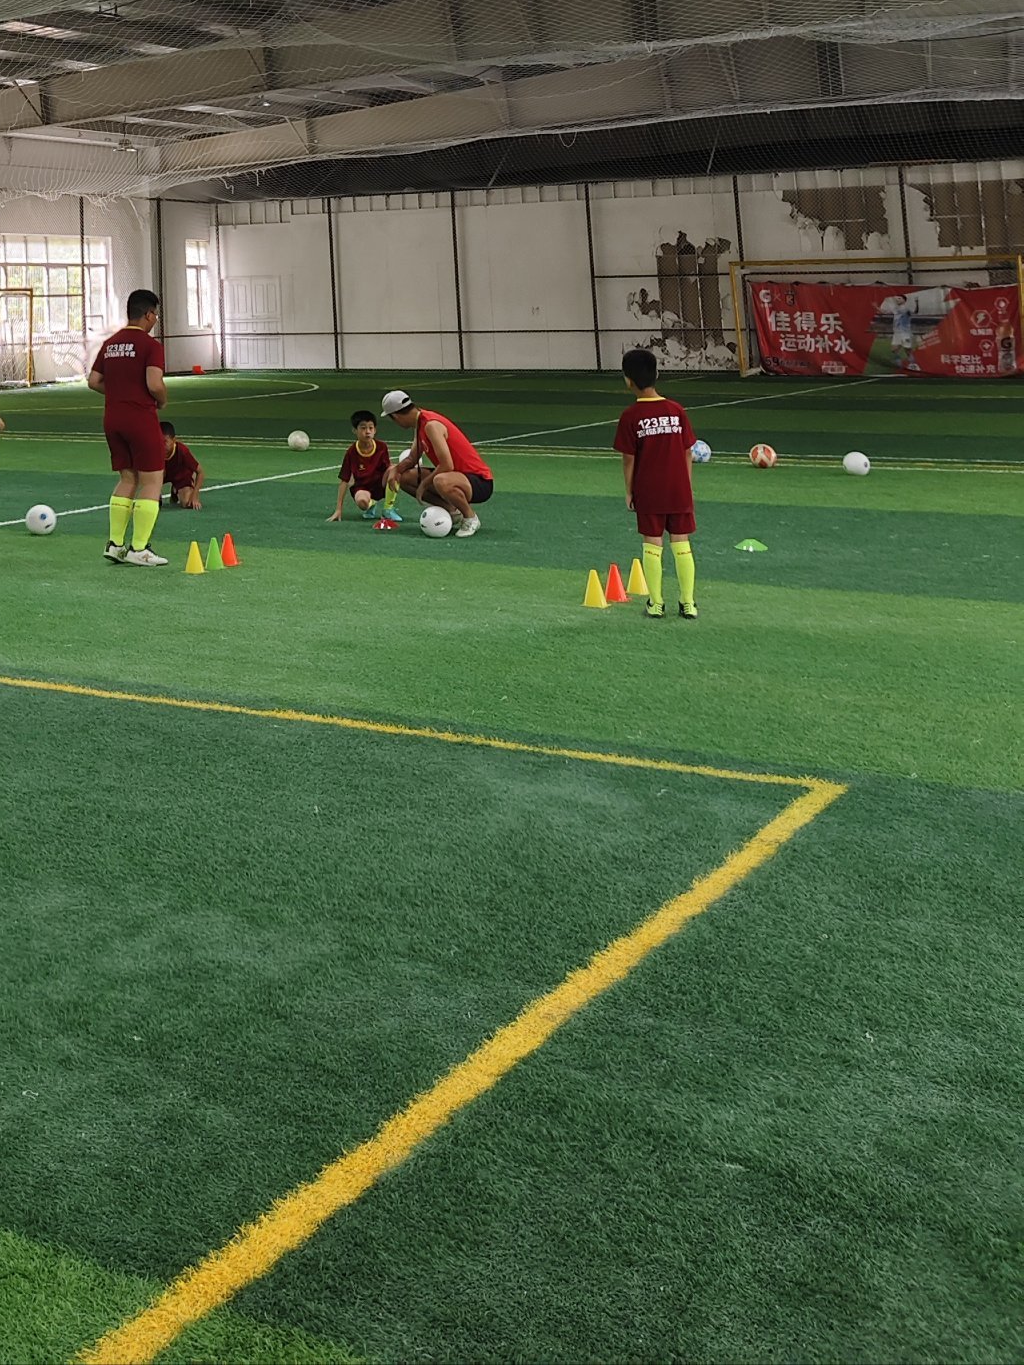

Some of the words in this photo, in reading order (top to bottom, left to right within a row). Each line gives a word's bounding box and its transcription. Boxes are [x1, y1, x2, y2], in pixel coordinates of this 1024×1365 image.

[769, 310, 844, 334] 佳得乐
[779, 333, 854, 354] 运动补水
[940, 354, 982, 365] 科学配比
[955, 364, 997, 374] 快速补充
[638, 415, 680, 430] 123足球
